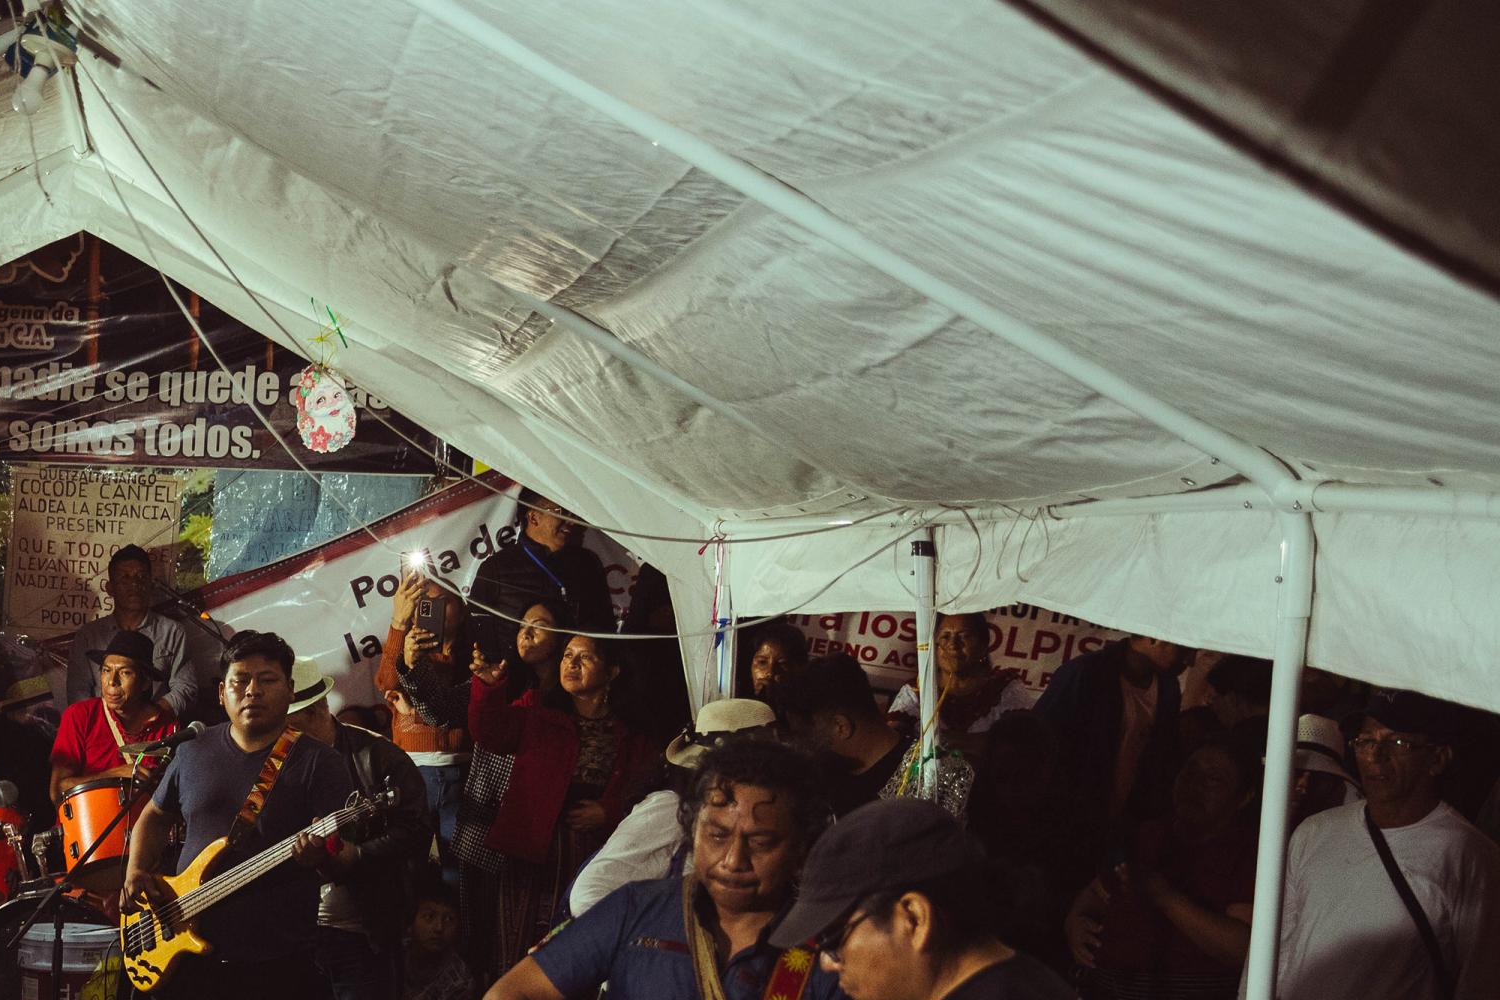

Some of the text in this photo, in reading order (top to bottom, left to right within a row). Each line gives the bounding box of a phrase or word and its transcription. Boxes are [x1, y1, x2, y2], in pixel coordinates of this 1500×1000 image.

[52, 303, 75, 321] de
[11, 324, 51, 346] C.A.
[102, 368, 150, 403] se
[159, 364, 280, 407] quede
[7, 419, 136, 457] somos
[144, 417, 261, 459] todos.
[38, 468, 158, 487] QUETZALTENANGO
[20, 478, 176, 504] COCODE CANTEL
[17, 498, 173, 522] ALDEA LA ESTANCIA
[46, 516, 126, 536] PRESENTE
[18, 537, 57, 556] QUE
[149, 548, 170, 563] SE
[17, 556, 100, 576] LEVANTEN
[14, 572, 70, 591] NADIE
[75, 577, 94, 593] SE
[349, 574, 400, 609] Po
[56, 593, 116, 612] ATRAS
[343, 632, 384, 664] la
